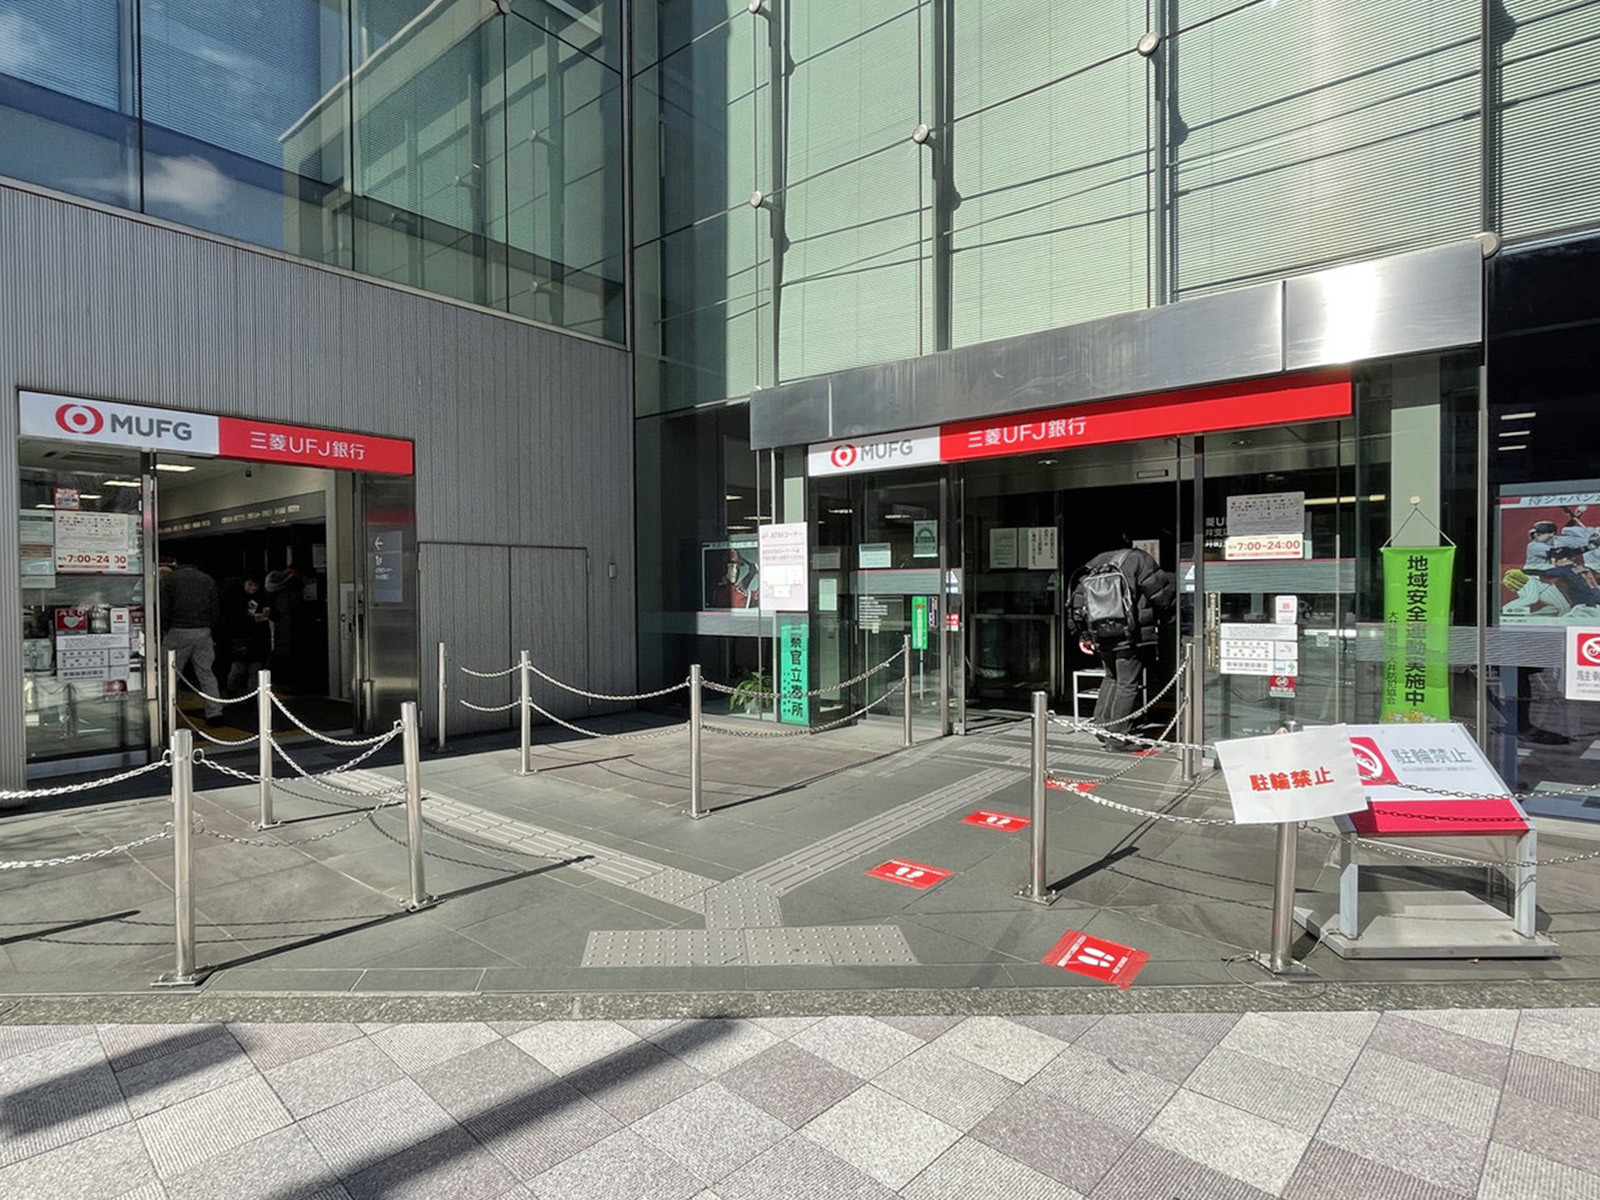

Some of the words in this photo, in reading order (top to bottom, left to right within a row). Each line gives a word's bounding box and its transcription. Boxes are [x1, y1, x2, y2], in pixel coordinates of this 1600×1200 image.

[110, 413, 192, 441] MUFG
[968, 417, 1087, 448] 三菱UFJ銀行
[250, 431, 365, 460] 三菱UFJ銀行
[860, 439, 913, 461] MUFG
[1391, 746, 1474, 765] 駐輪禁止
[1249, 766, 1335, 792] 駐輪禁止
